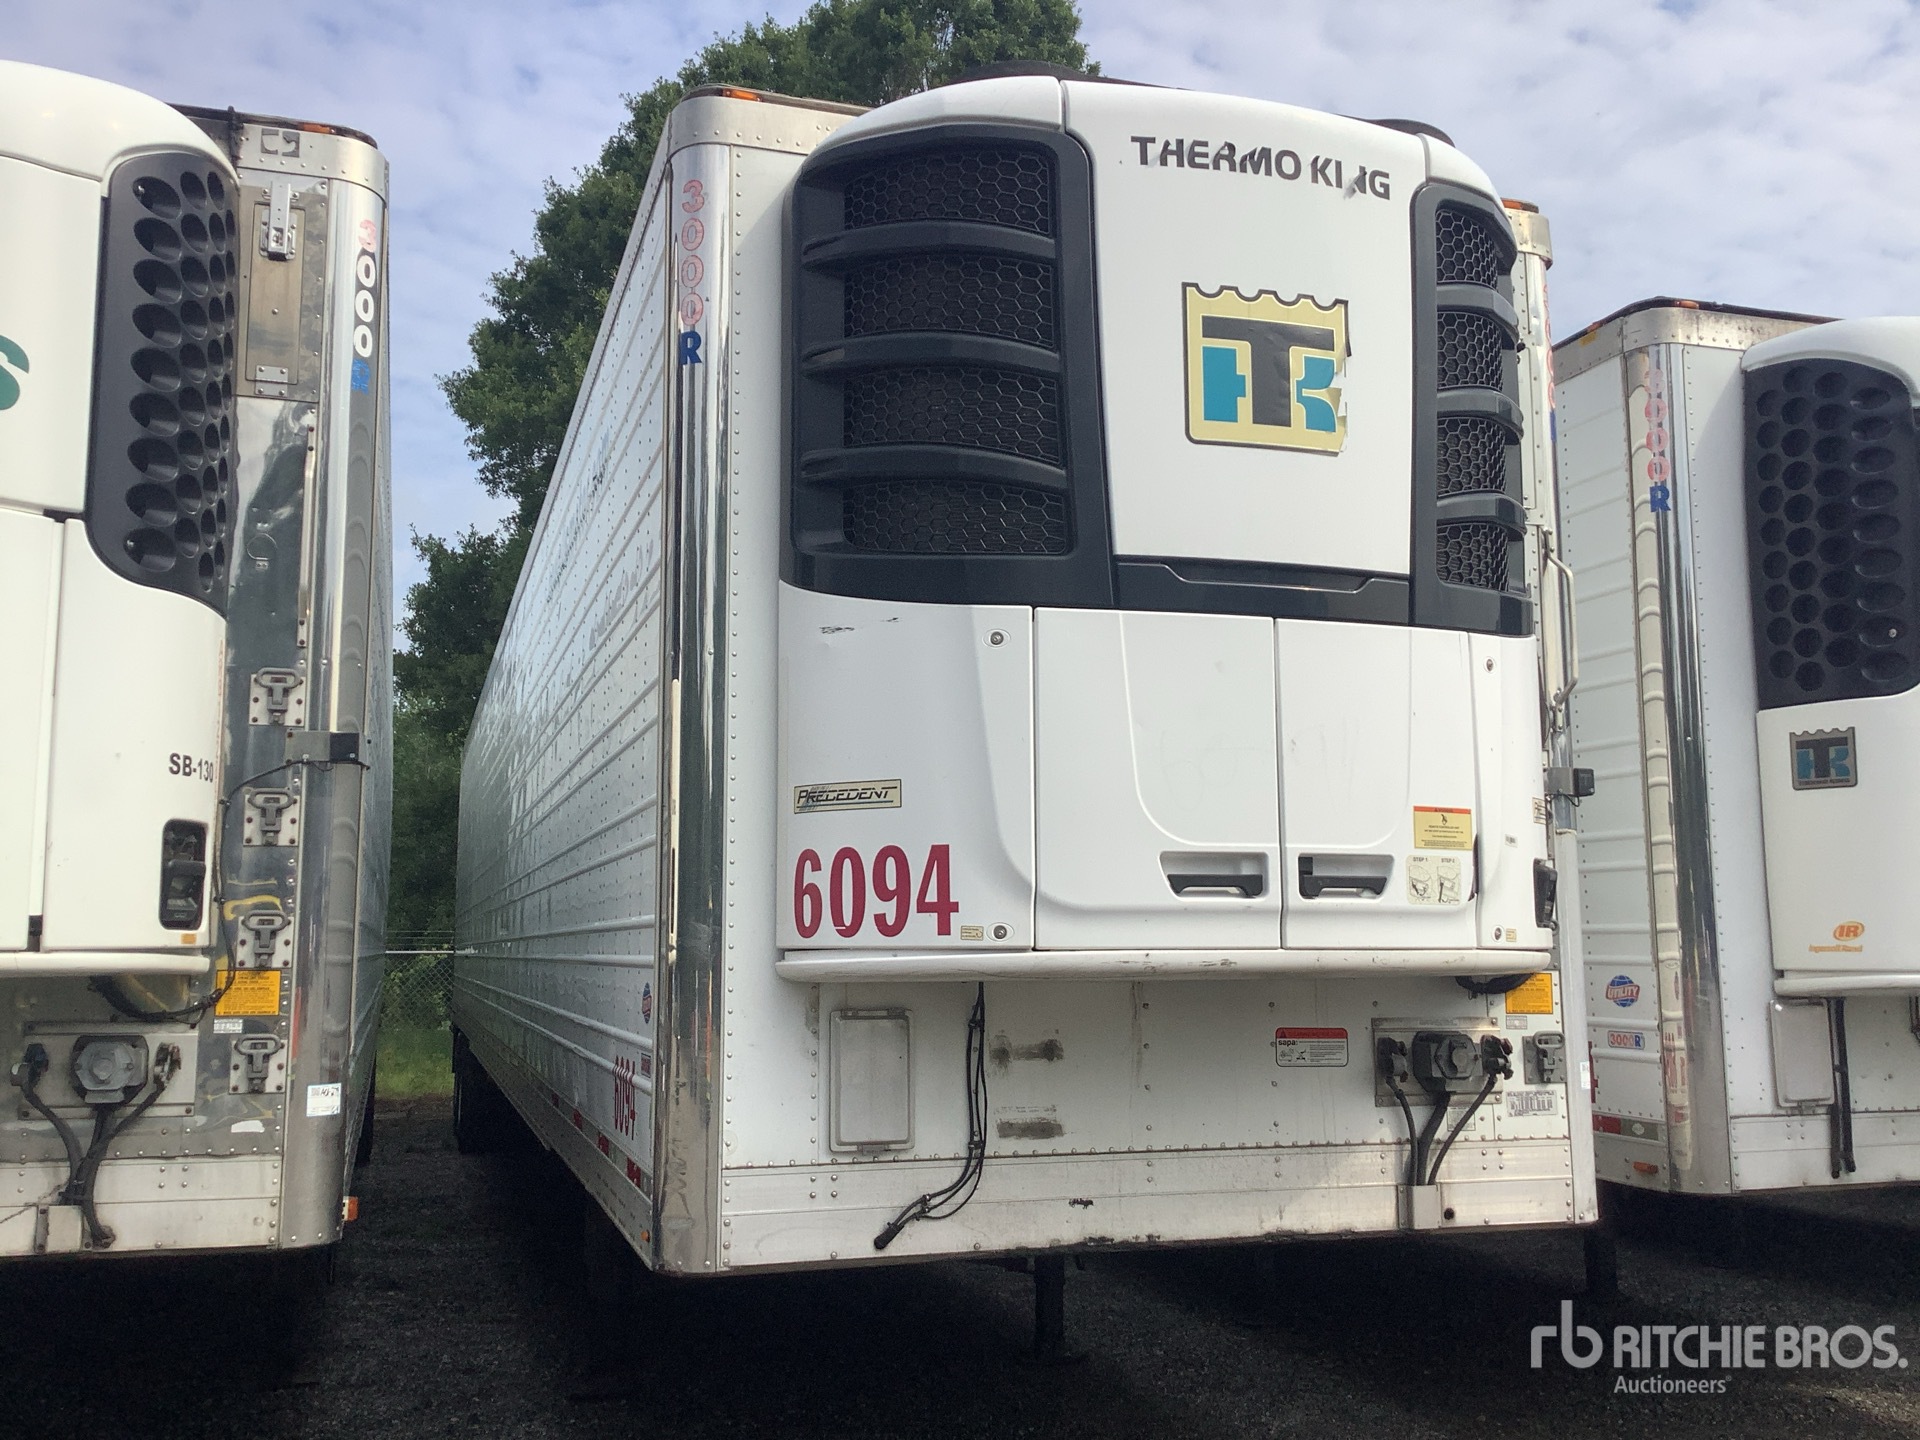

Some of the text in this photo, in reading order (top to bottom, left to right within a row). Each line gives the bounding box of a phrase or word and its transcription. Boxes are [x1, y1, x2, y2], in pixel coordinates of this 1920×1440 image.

[1130, 135, 1302, 181] THERMO
[680, 179, 705, 366] 3000R
[168, 752, 214, 783] SB-130
[797, 786, 898, 804] PRECEDENT
[793, 843, 960, 939] 6094
[1838, 924, 1860, 938] IR
[1607, 985, 1639, 999] UTILITY
[614, 1054, 635, 1141] 6094
